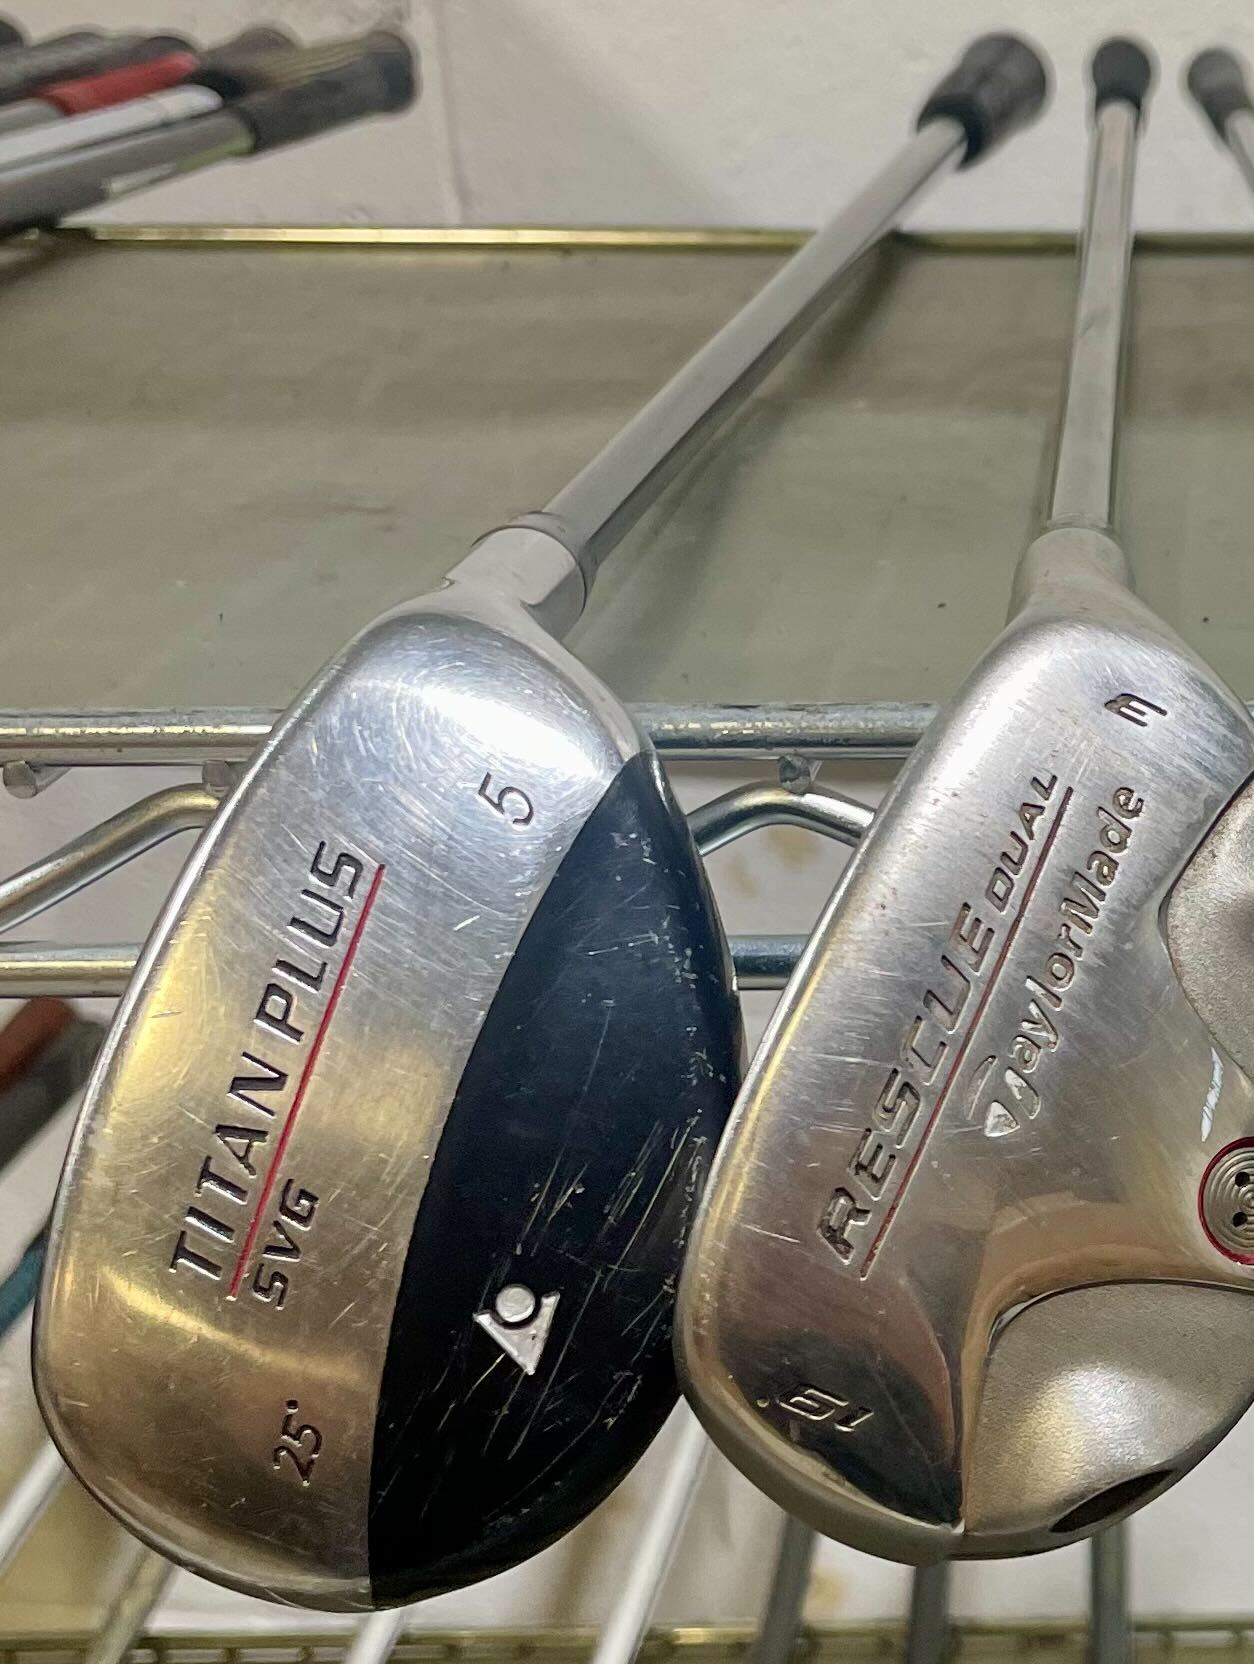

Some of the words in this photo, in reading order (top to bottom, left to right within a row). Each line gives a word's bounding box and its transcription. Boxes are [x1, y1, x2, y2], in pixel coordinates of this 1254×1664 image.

[476, 770, 536, 830] 5
[966, 783, 1146, 1139] TaylorMade
[169, 1051, 289, 1281] TITAN
[252, 840, 364, 1044] PLUS
[815, 902, 996, 1264] RESCUE
[984, 772, 1059, 915] DUAL
[252, 1178, 321, 1311] SVG
